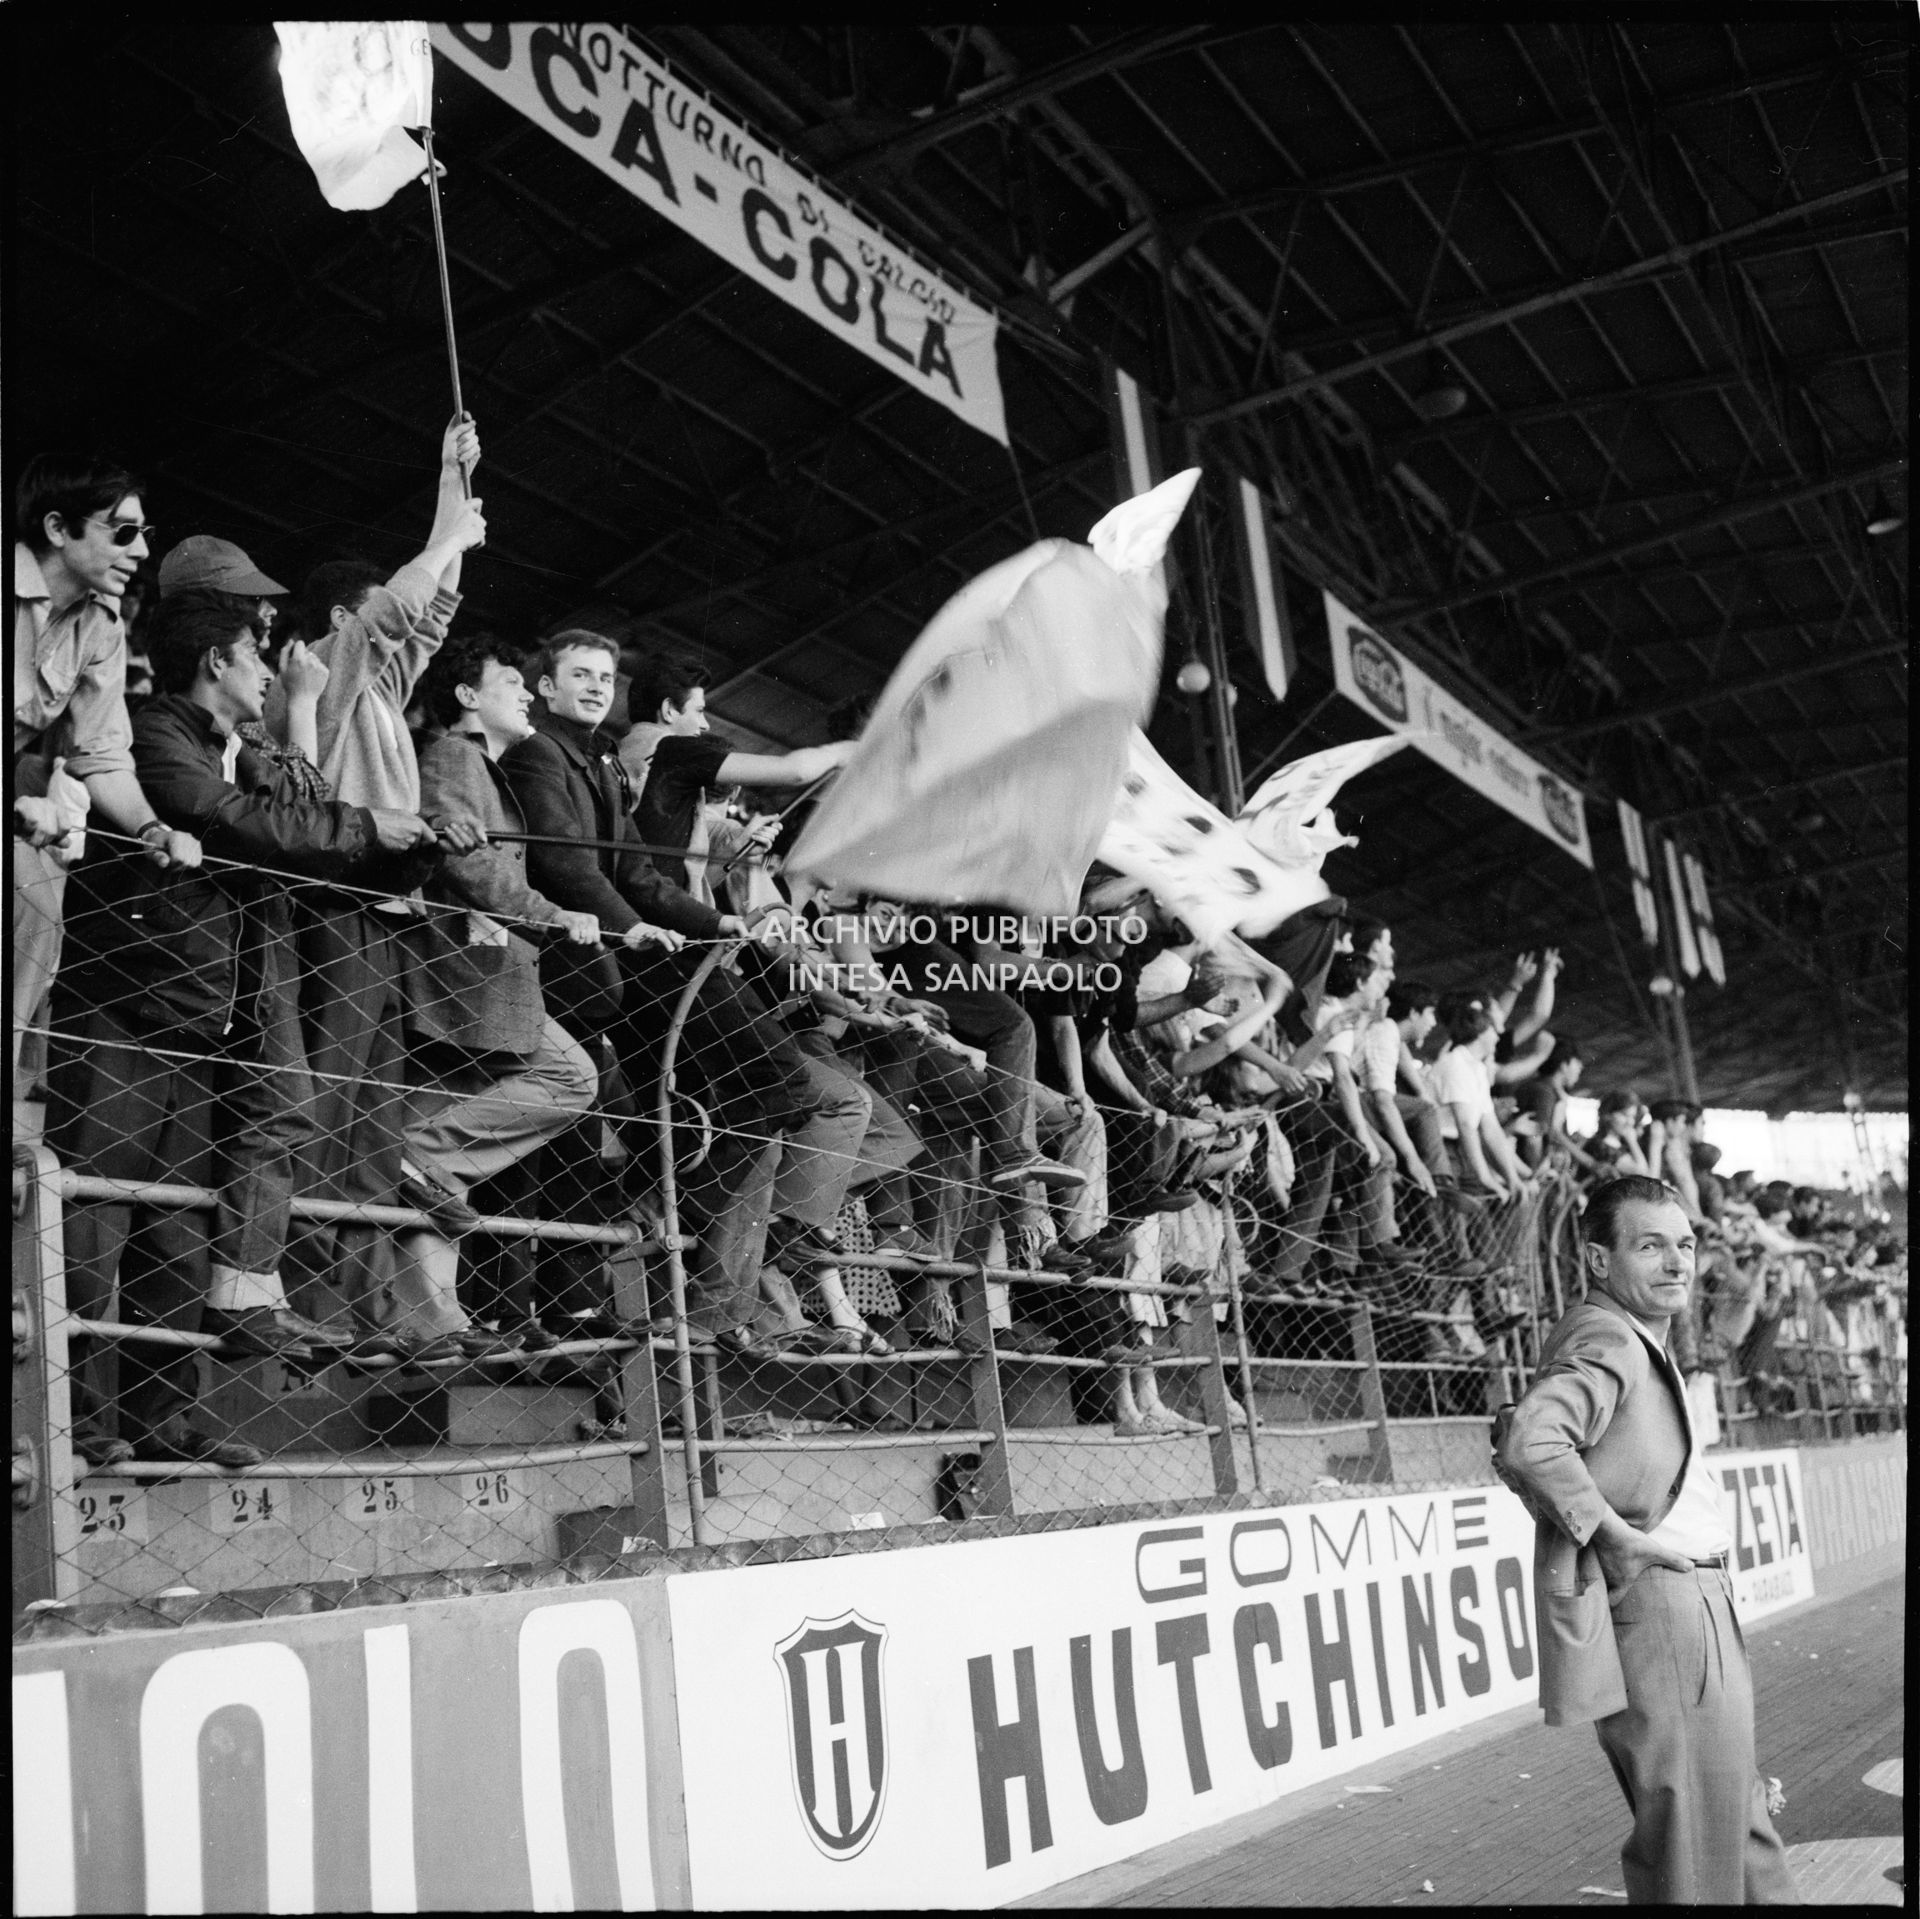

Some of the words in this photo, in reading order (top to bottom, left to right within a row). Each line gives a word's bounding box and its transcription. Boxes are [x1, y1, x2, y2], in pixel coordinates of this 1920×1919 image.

[231, 1487, 273, 1523] 24
[362, 1480, 398, 1513] 25
[475, 1473, 508, 1507] 26
[79, 1494, 126, 1534] 23
[1136, 1496, 1489, 1604] GOMME
